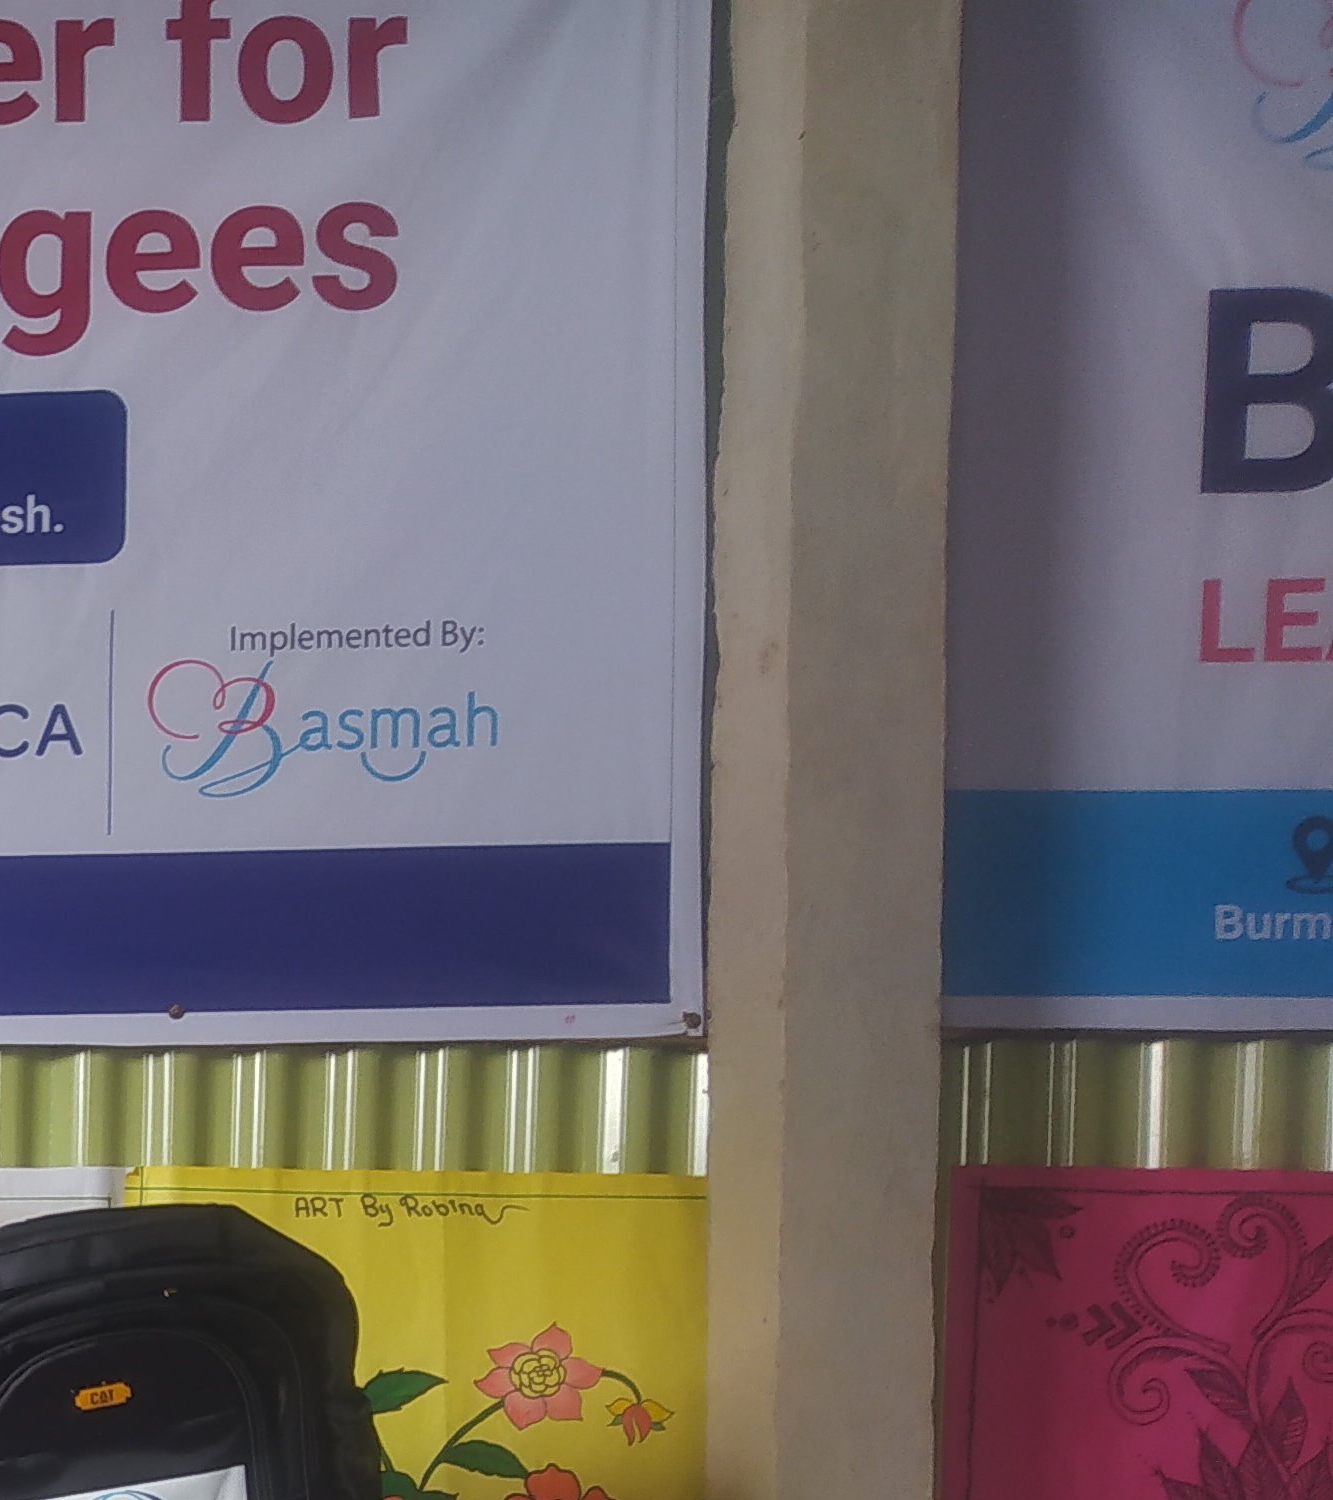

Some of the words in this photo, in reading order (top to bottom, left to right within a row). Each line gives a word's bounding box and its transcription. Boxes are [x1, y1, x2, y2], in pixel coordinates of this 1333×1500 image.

[167, 0, 408, 123] for
[230, 621, 431, 656] Implemented
[442, 621, 485, 652] By:
[1200, 578, 1333, 662] LE
[147, 659, 499, 797] Basmah
[295, 1197, 344, 1218] ART
[361, 1193, 393, 1227] By
